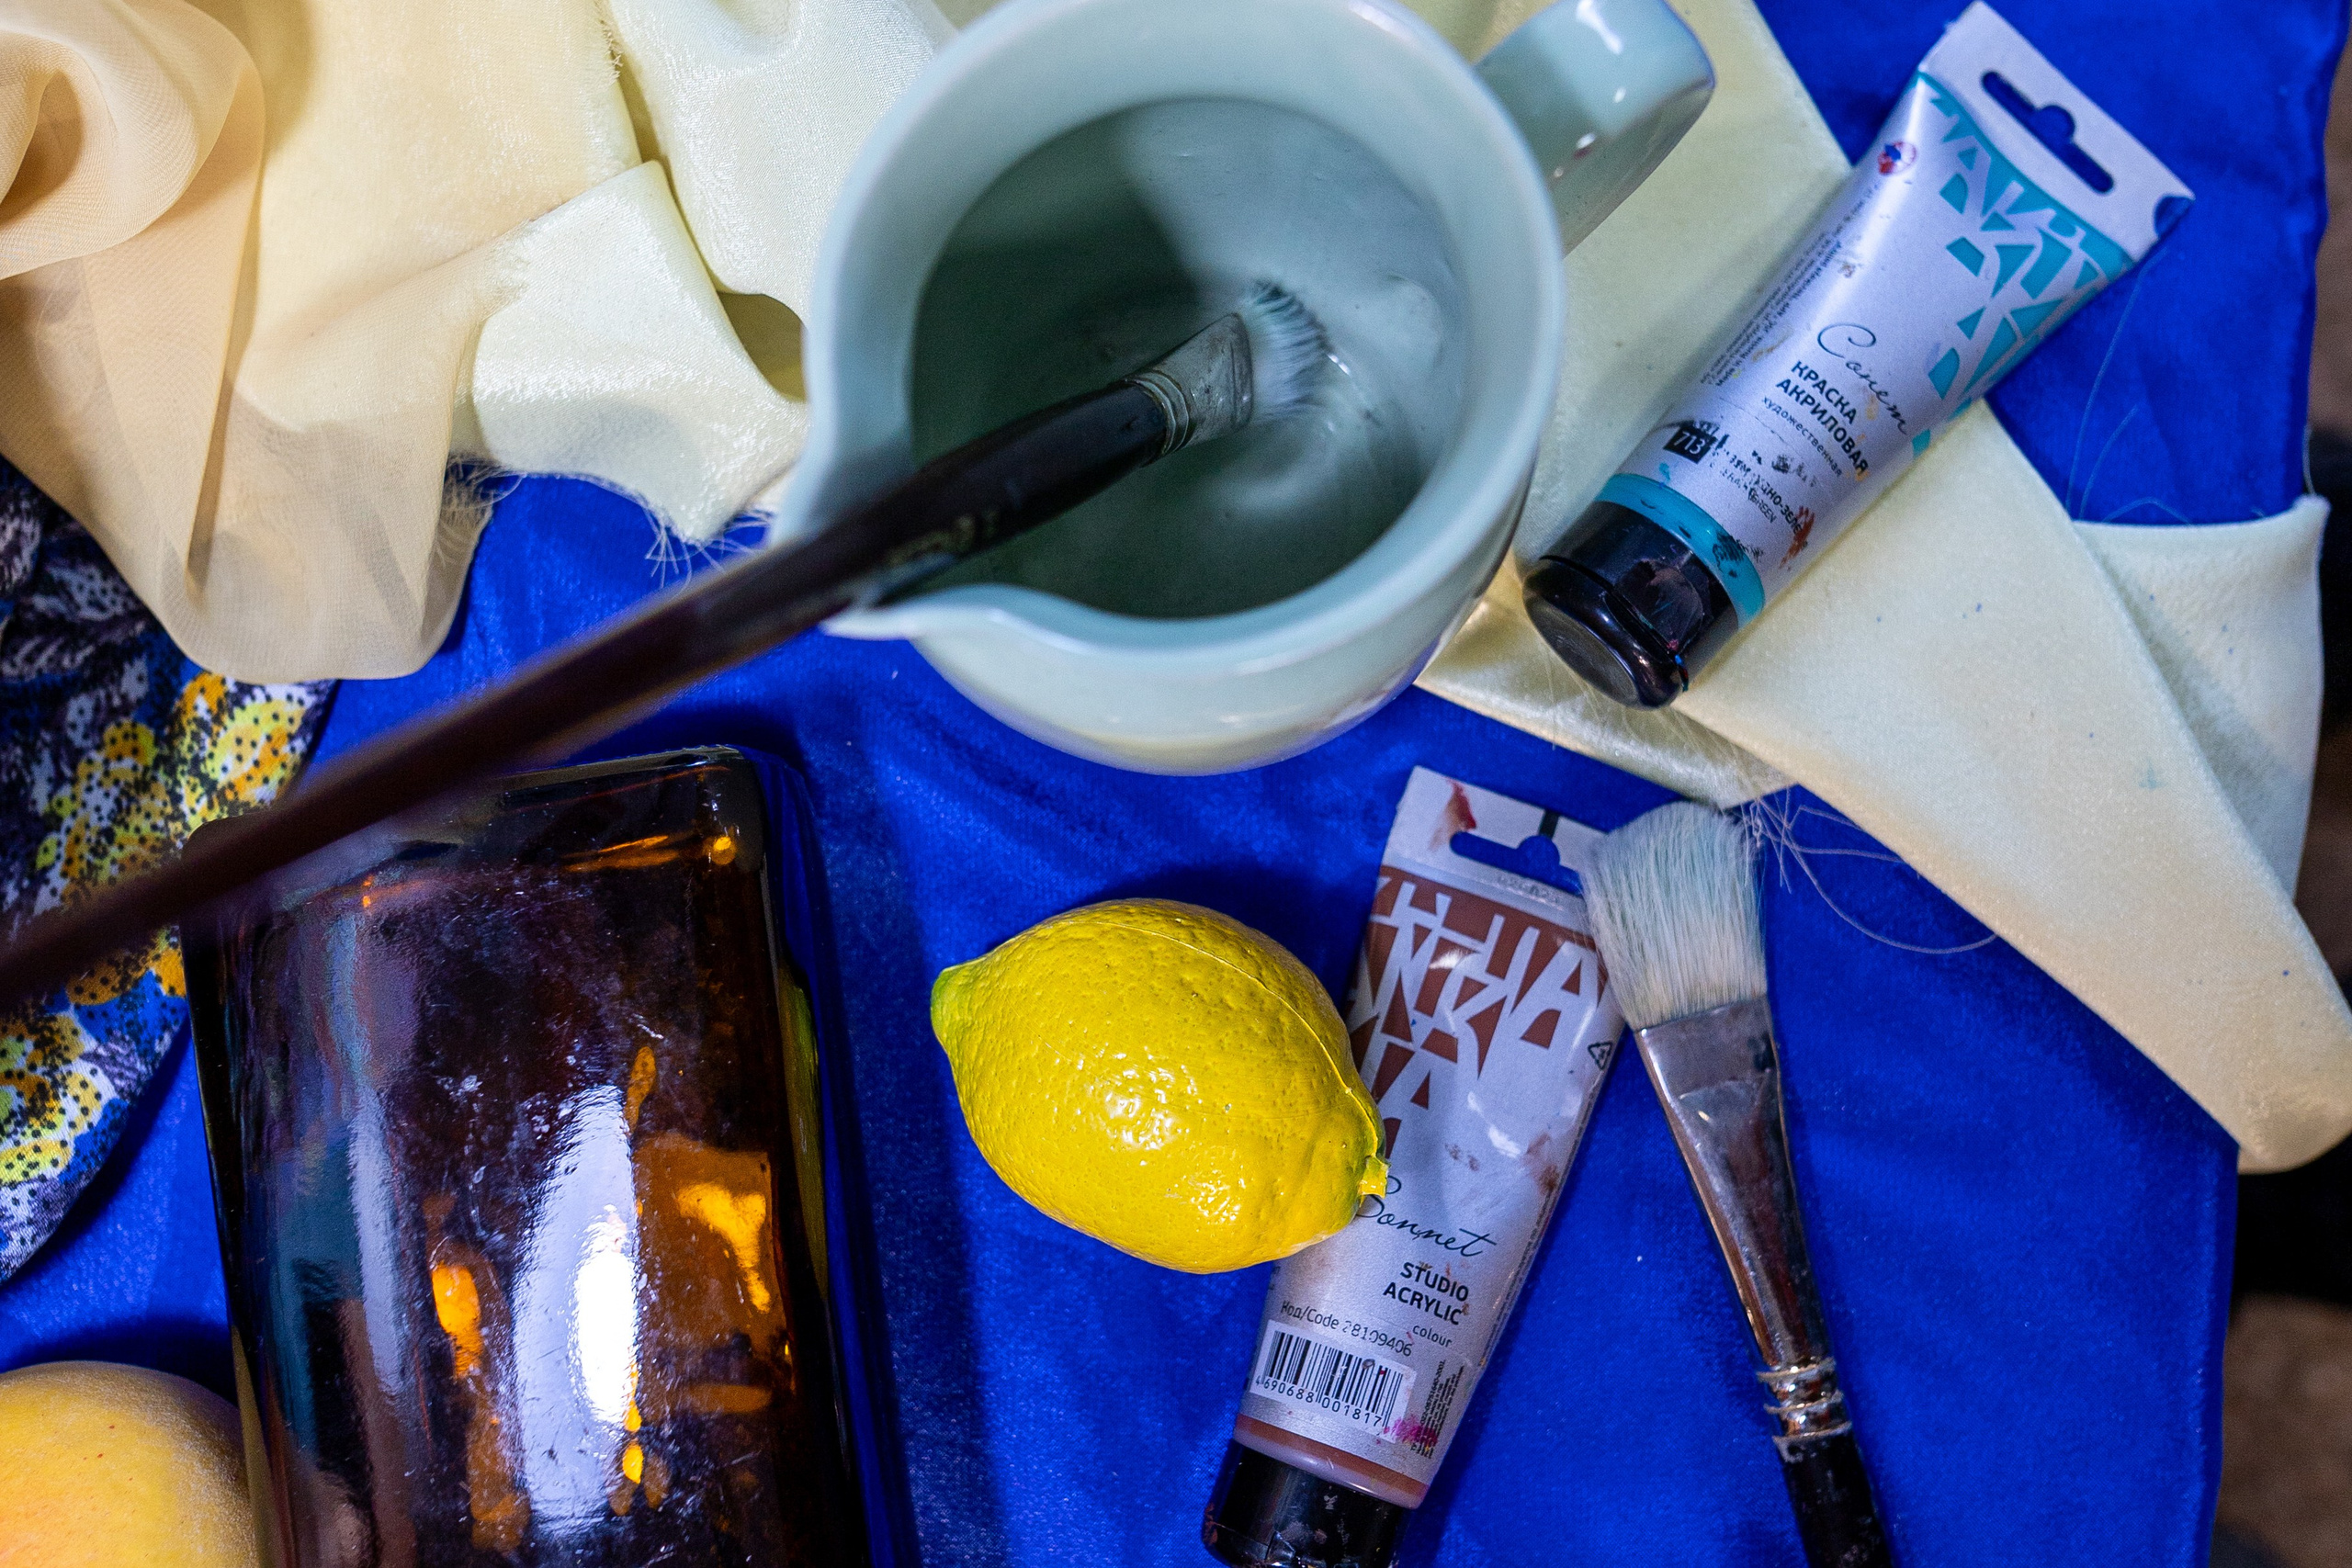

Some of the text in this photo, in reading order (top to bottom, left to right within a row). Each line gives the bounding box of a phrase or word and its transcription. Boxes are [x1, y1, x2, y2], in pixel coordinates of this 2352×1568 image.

[1792, 360, 1858, 424] КРАСКА
[1675, 427, 1705, 456] 713
[1762, 396, 1843, 477] художественная
[1776, 378, 1869, 475] АКРИЛОВАЯ
[1383, 1282, 1463, 1325] ACRYLIC
[1399, 1262, 1469, 1302] STUDIO
[1342, 1321, 1413, 1357] 28109406
[1412, 1325, 1453, 1348] colour
[1263, 1378, 1315, 1404] 690688
[1321, 1396, 1382, 1427] 001817
